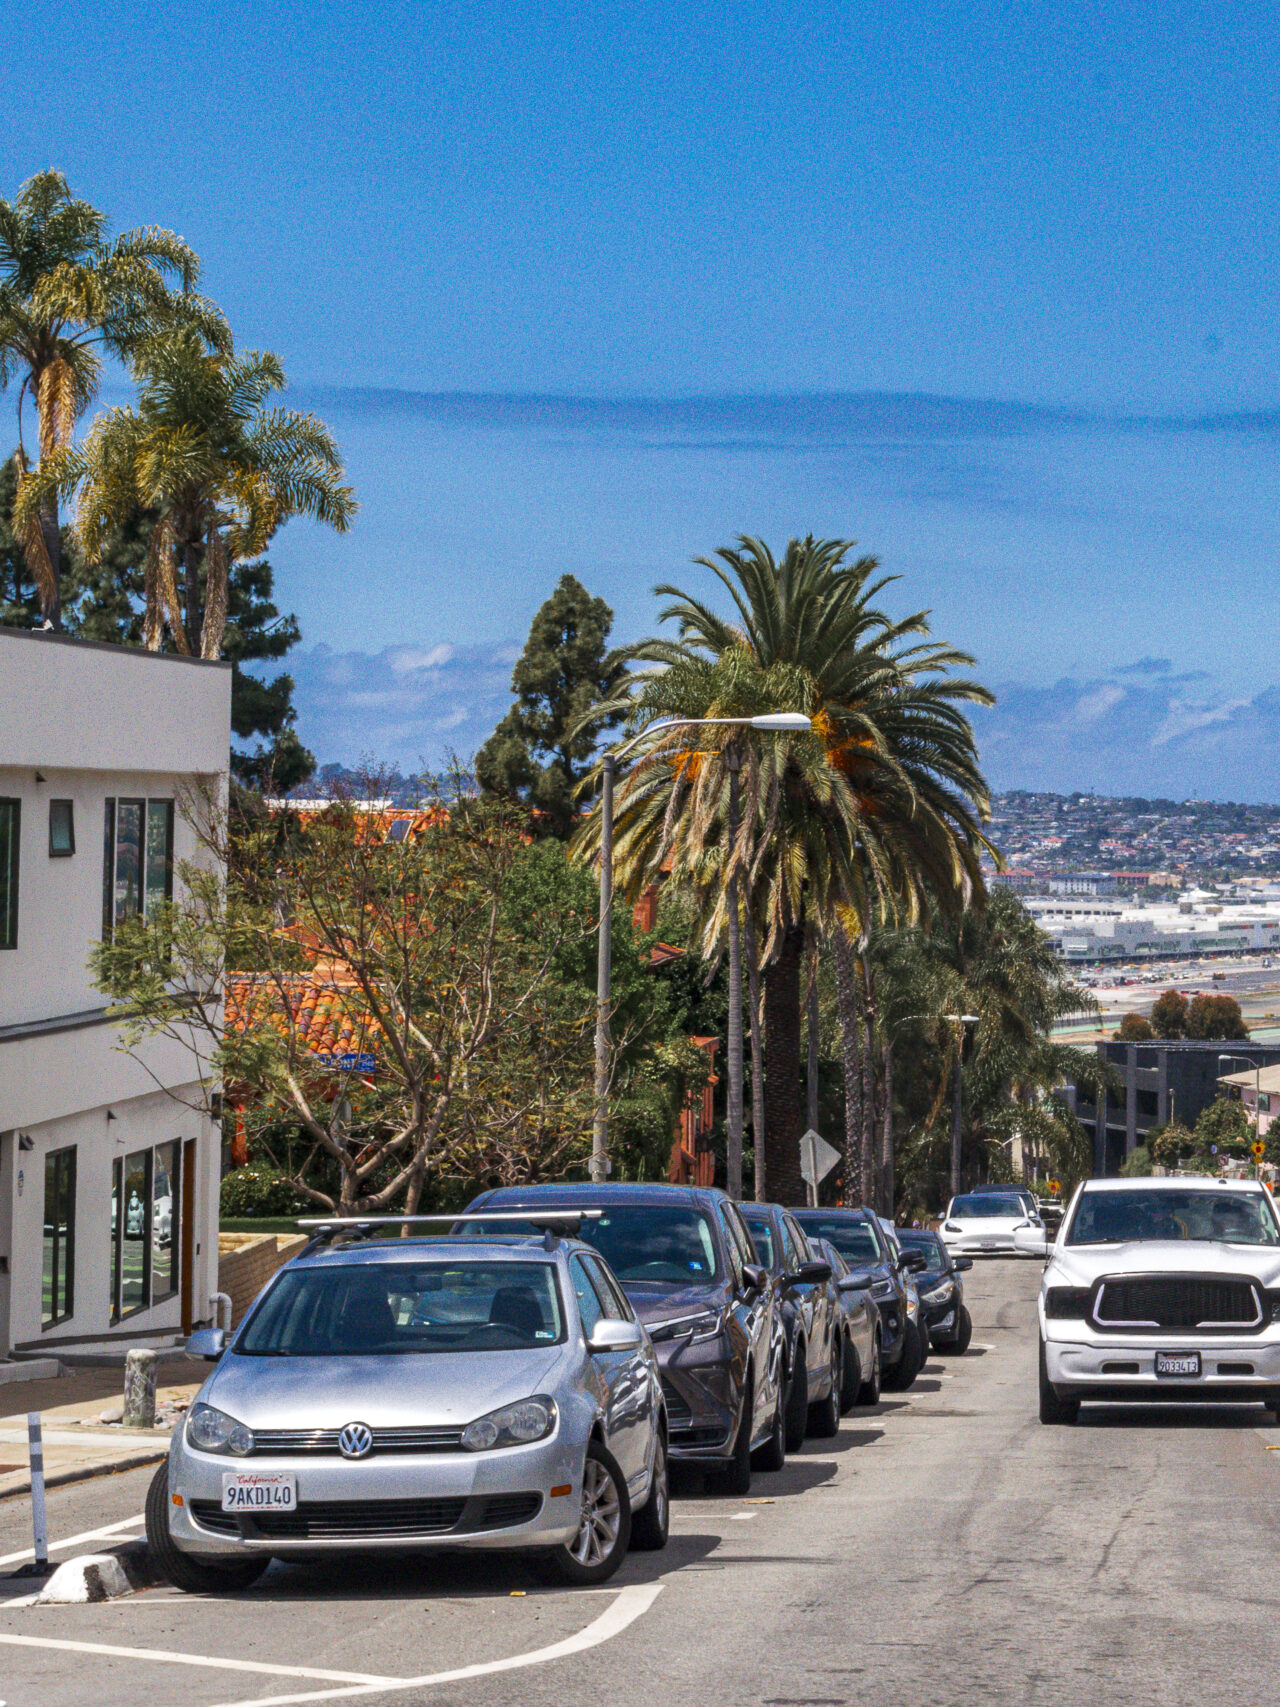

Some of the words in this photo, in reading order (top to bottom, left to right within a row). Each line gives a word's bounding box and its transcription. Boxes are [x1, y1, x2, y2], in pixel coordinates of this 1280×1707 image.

[1159, 1361, 1197, 1372] 90334T3
[237, 1474, 282, 1486] California
[227, 1486, 291, 1505] 9AKD140
